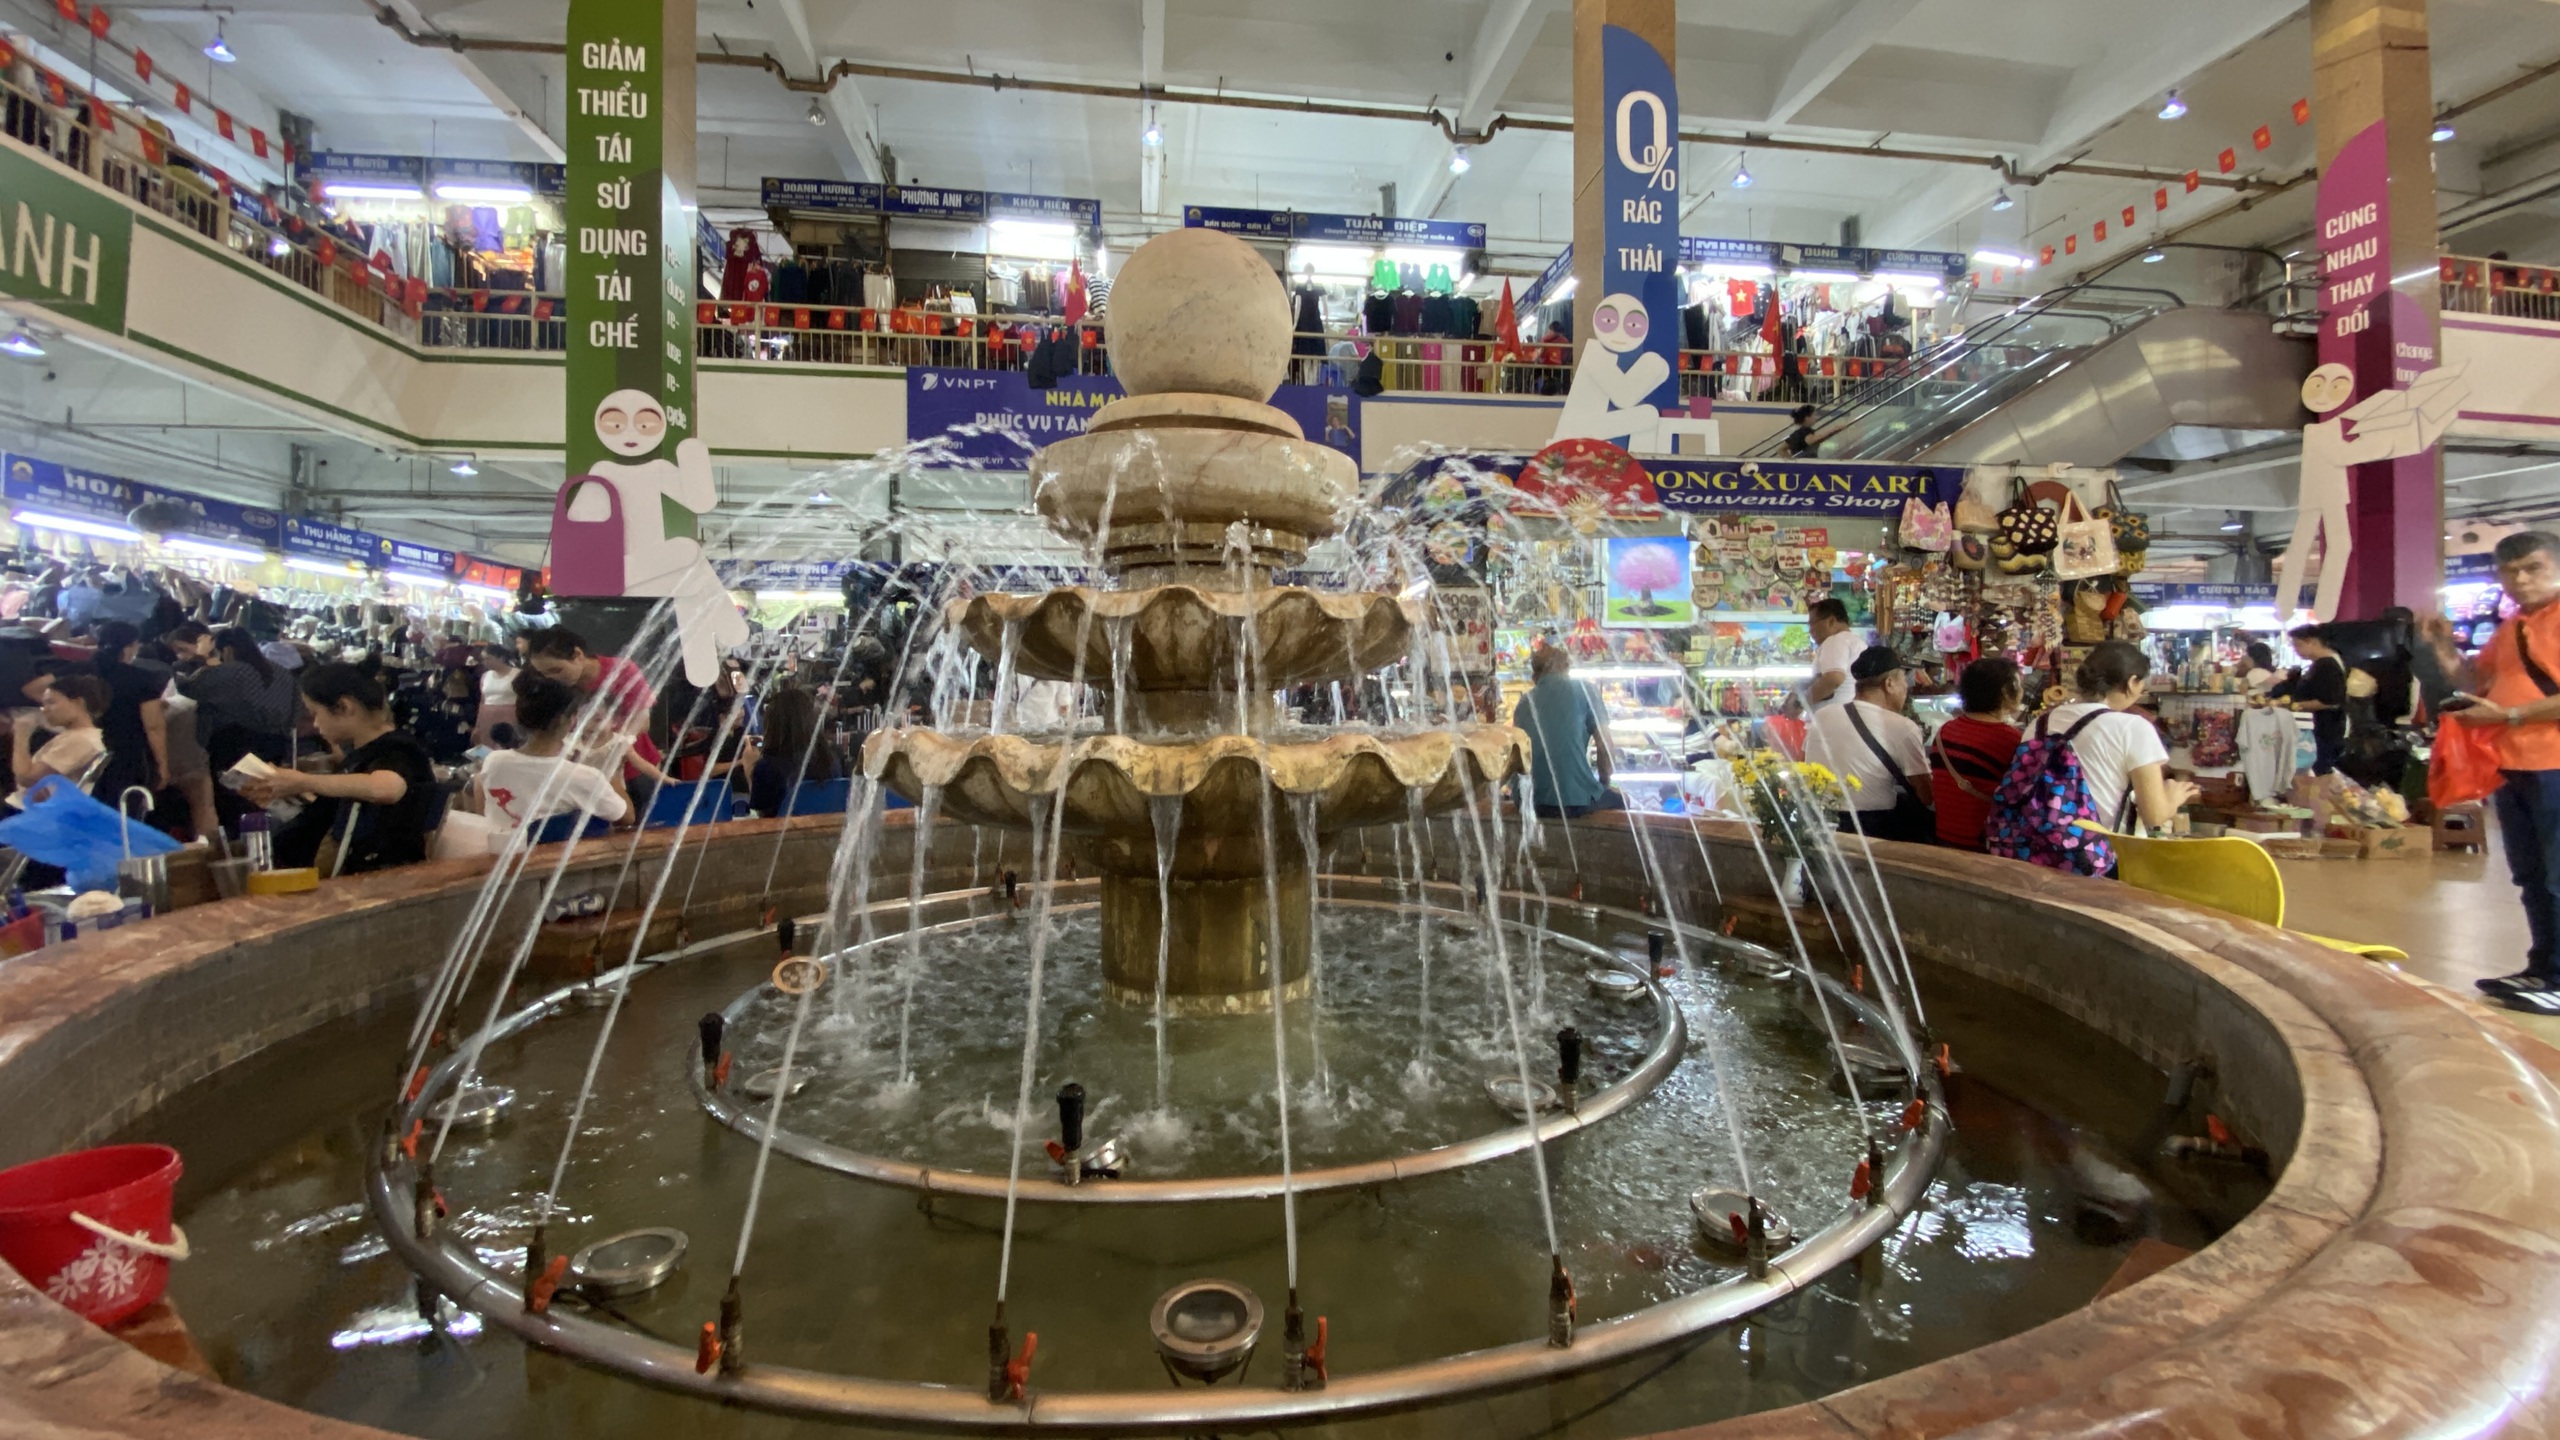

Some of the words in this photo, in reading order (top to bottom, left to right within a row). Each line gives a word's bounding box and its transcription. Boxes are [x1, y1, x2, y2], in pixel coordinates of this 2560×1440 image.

[583, 37, 646, 72] GIẢM
[577, 80, 647, 119] THIỂU
[595, 132, 632, 163] TÁI
[1616, 90, 1676, 191] 0%
[597, 175, 632, 210] SỬ
[783, 183, 817, 193] DOANH
[942, 192, 962, 208] ANH
[1623, 194, 1662, 224] RÁC
[2325, 202, 2377, 239] CÙNG
[1394, 220, 1428, 234] ĐIỆP
[0, 200, 99, 306] NH
[580, 228, 647, 259] DỤNG
[1618, 243, 1662, 272] THẢI
[1696, 240, 1762, 252] MINH
[2326, 237, 2378, 273] NHAU
[595, 269, 632, 301] TÁI
[2330, 272, 2376, 305] THAY
[589, 313, 639, 348] CHẾ
[2336, 304, 2370, 338] ĐỔI
[943, 377, 997, 389] VNPT
[1046, 389, 1086, 407] NHÀ
[1027, 414, 1051, 433] VỤ
[1750, 471, 1852, 492] XUAN
[1862, 474, 1933, 494] ART
[1664, 490, 1815, 507] Souvenirs
[1825, 494, 1900, 509] Shop
